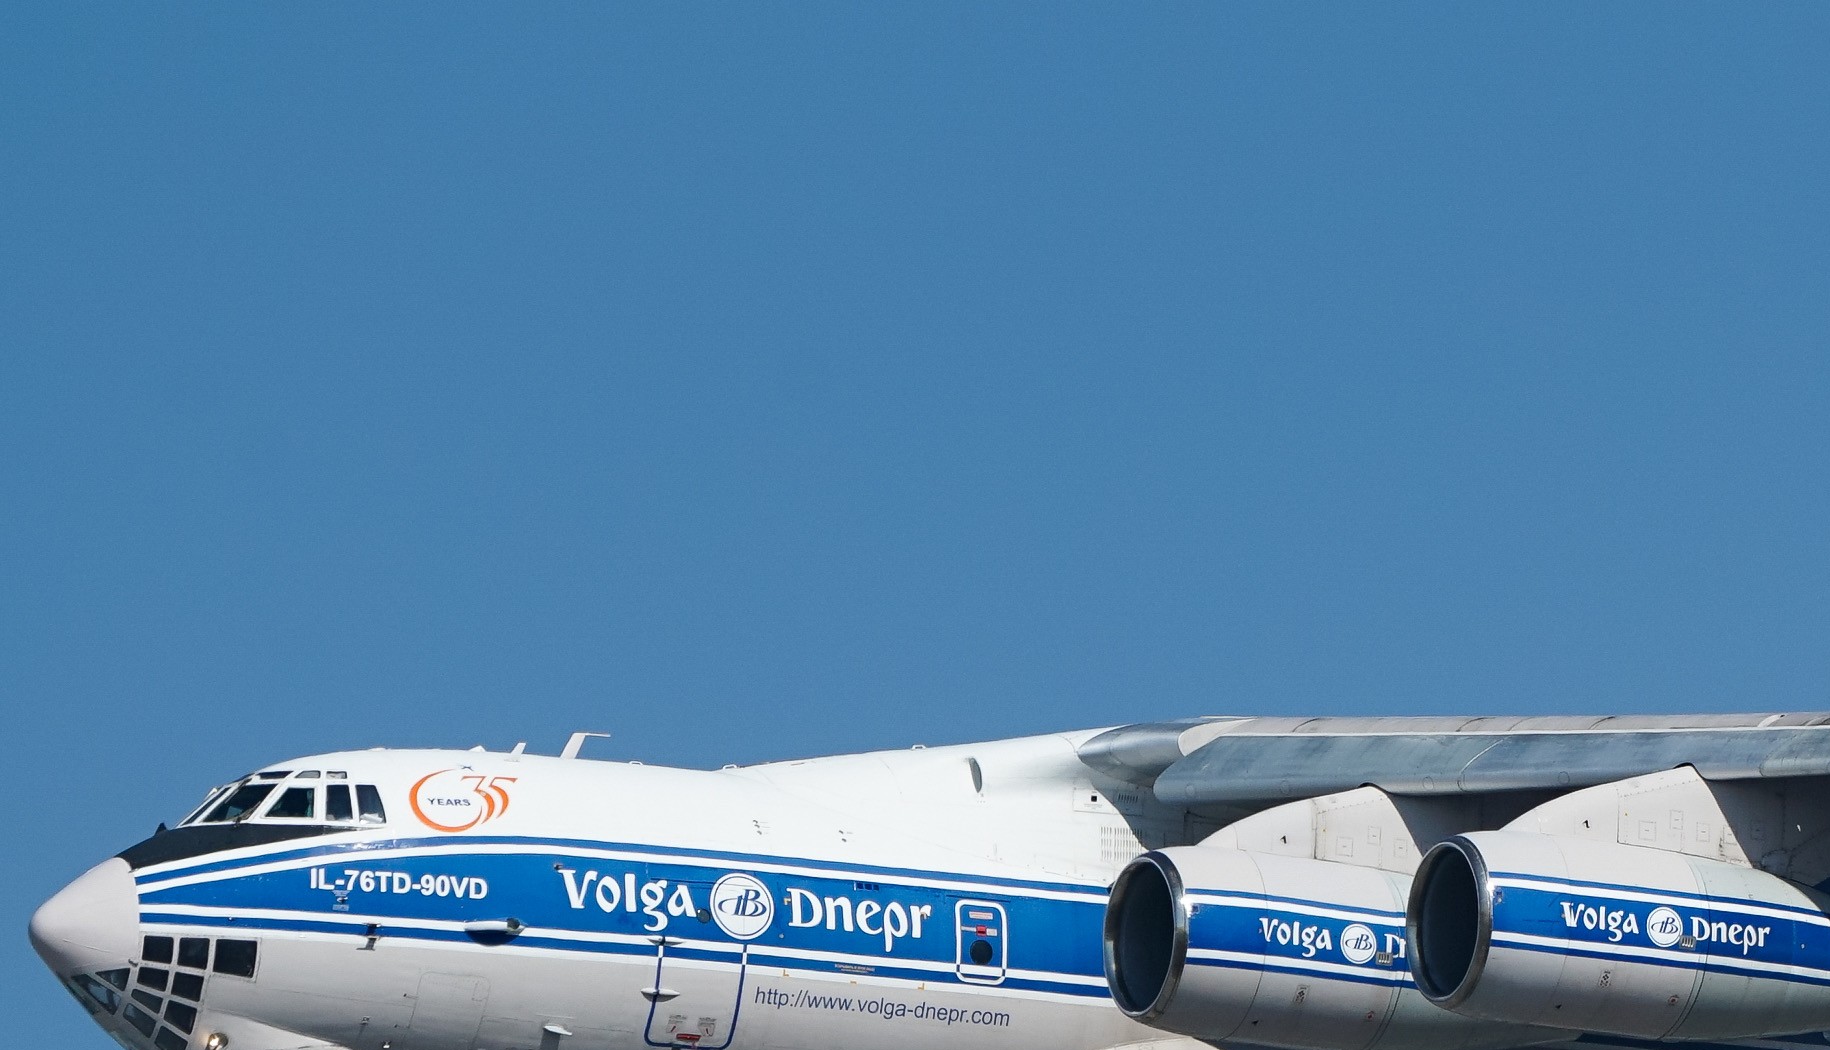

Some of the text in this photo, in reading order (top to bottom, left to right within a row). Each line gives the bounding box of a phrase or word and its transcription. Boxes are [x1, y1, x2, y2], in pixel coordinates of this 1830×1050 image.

[428, 797, 471, 807] YEARS
[310, 867, 488, 900] IL-76TD-90VD
[558, 868, 698, 932] Volga
[786, 887, 932, 953] Dnepr
[1559, 901, 1639, 942] Volga
[1690, 916, 1771, 956] Dnepr
[1259, 917, 1333, 958] Volga
[754, 986, 1010, 1027] http://www.volga-dnepr.com
